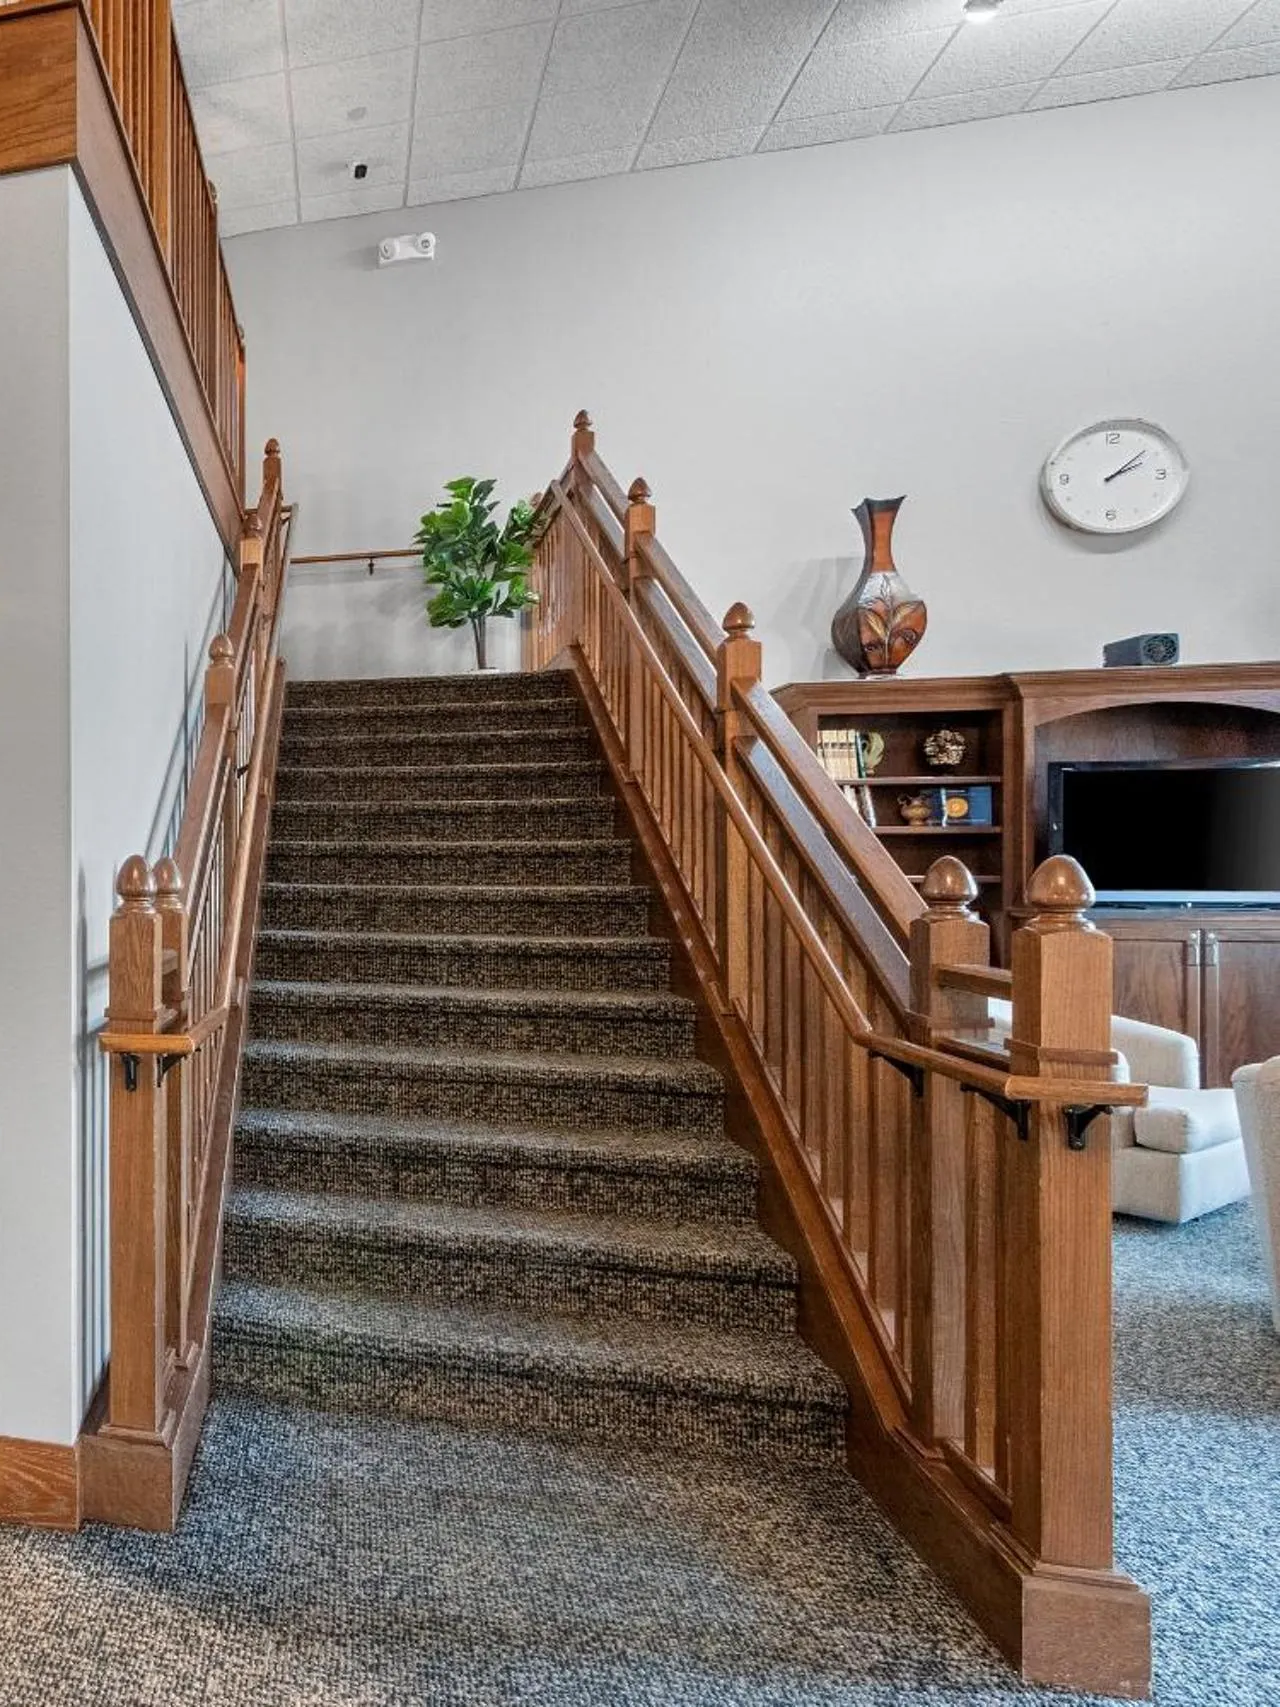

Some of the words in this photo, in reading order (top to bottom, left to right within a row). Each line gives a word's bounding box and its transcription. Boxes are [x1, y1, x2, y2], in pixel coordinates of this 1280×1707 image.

[1105, 433, 1120, 445] 12
[1059, 474, 1069, 485] 9
[1155, 469, 1167, 480] 3
[1105, 510, 1116, 520] 6
